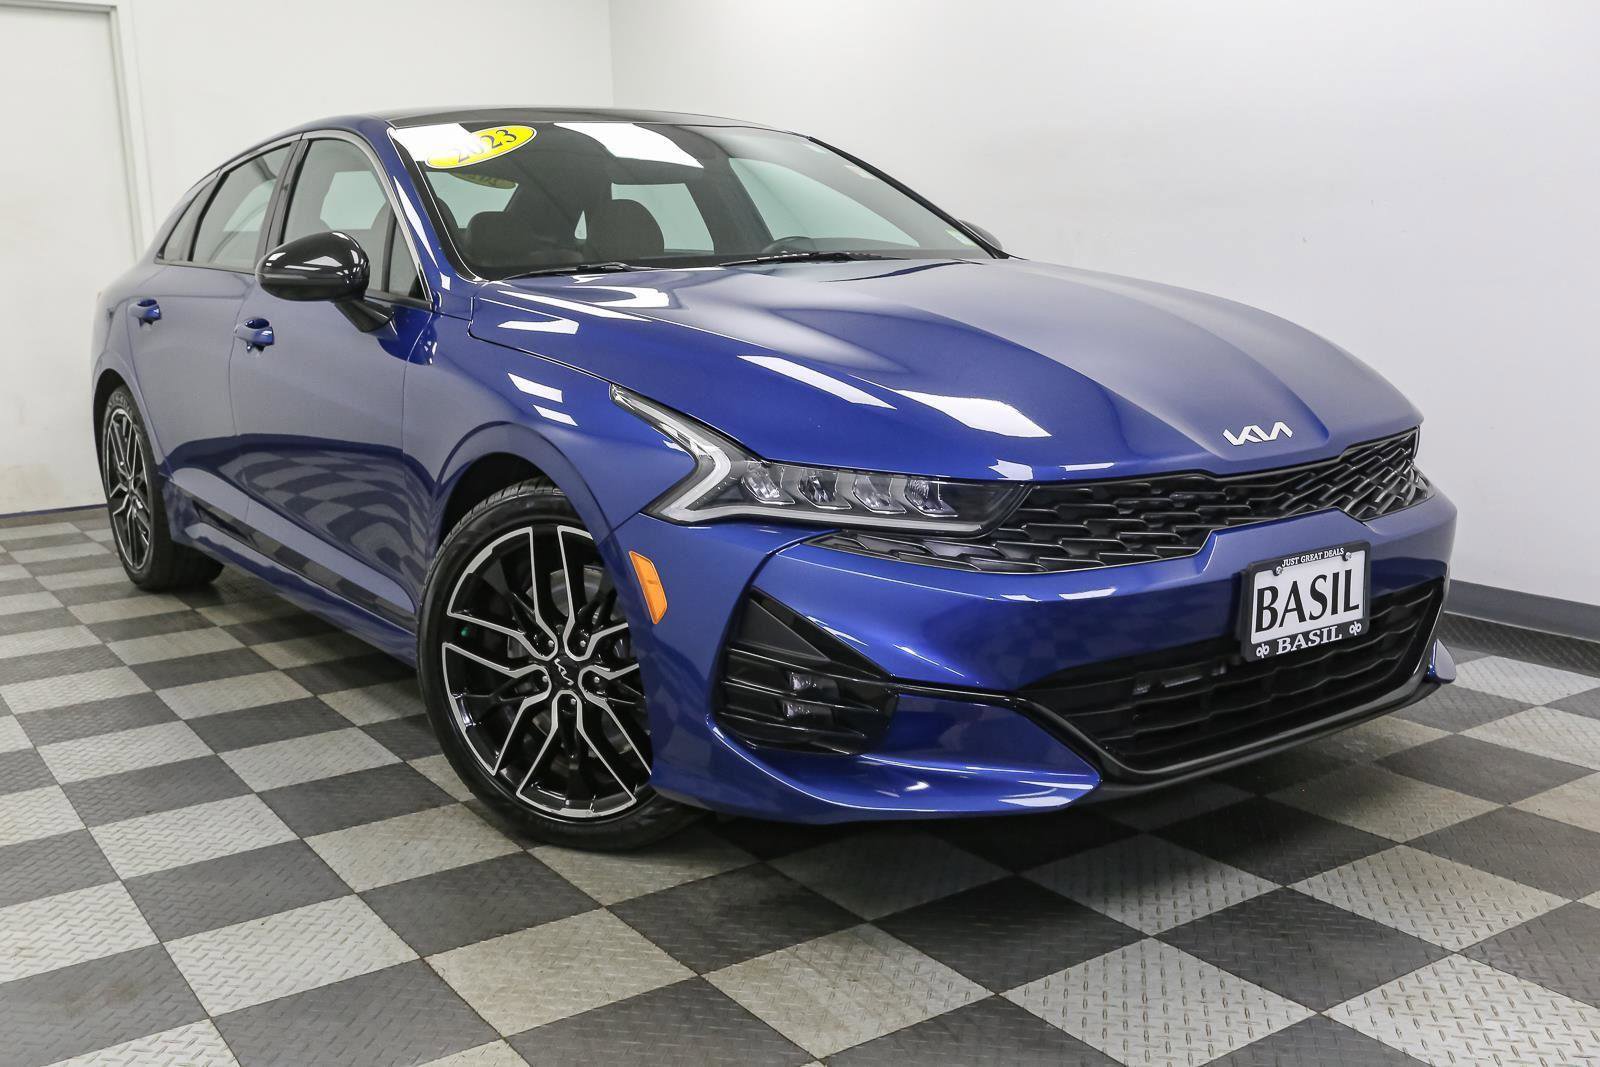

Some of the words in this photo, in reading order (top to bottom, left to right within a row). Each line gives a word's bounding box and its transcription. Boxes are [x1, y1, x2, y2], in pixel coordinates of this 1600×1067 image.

[1222, 421, 1293, 446] KIA
[1281, 557, 1300, 567] JUST
[1301, 552, 1323, 563] GREAT
[1324, 547, 1345, 559] DEALS
[1255, 569, 1360, 633] BASIL
[1276, 626, 1342, 655] BASIL
